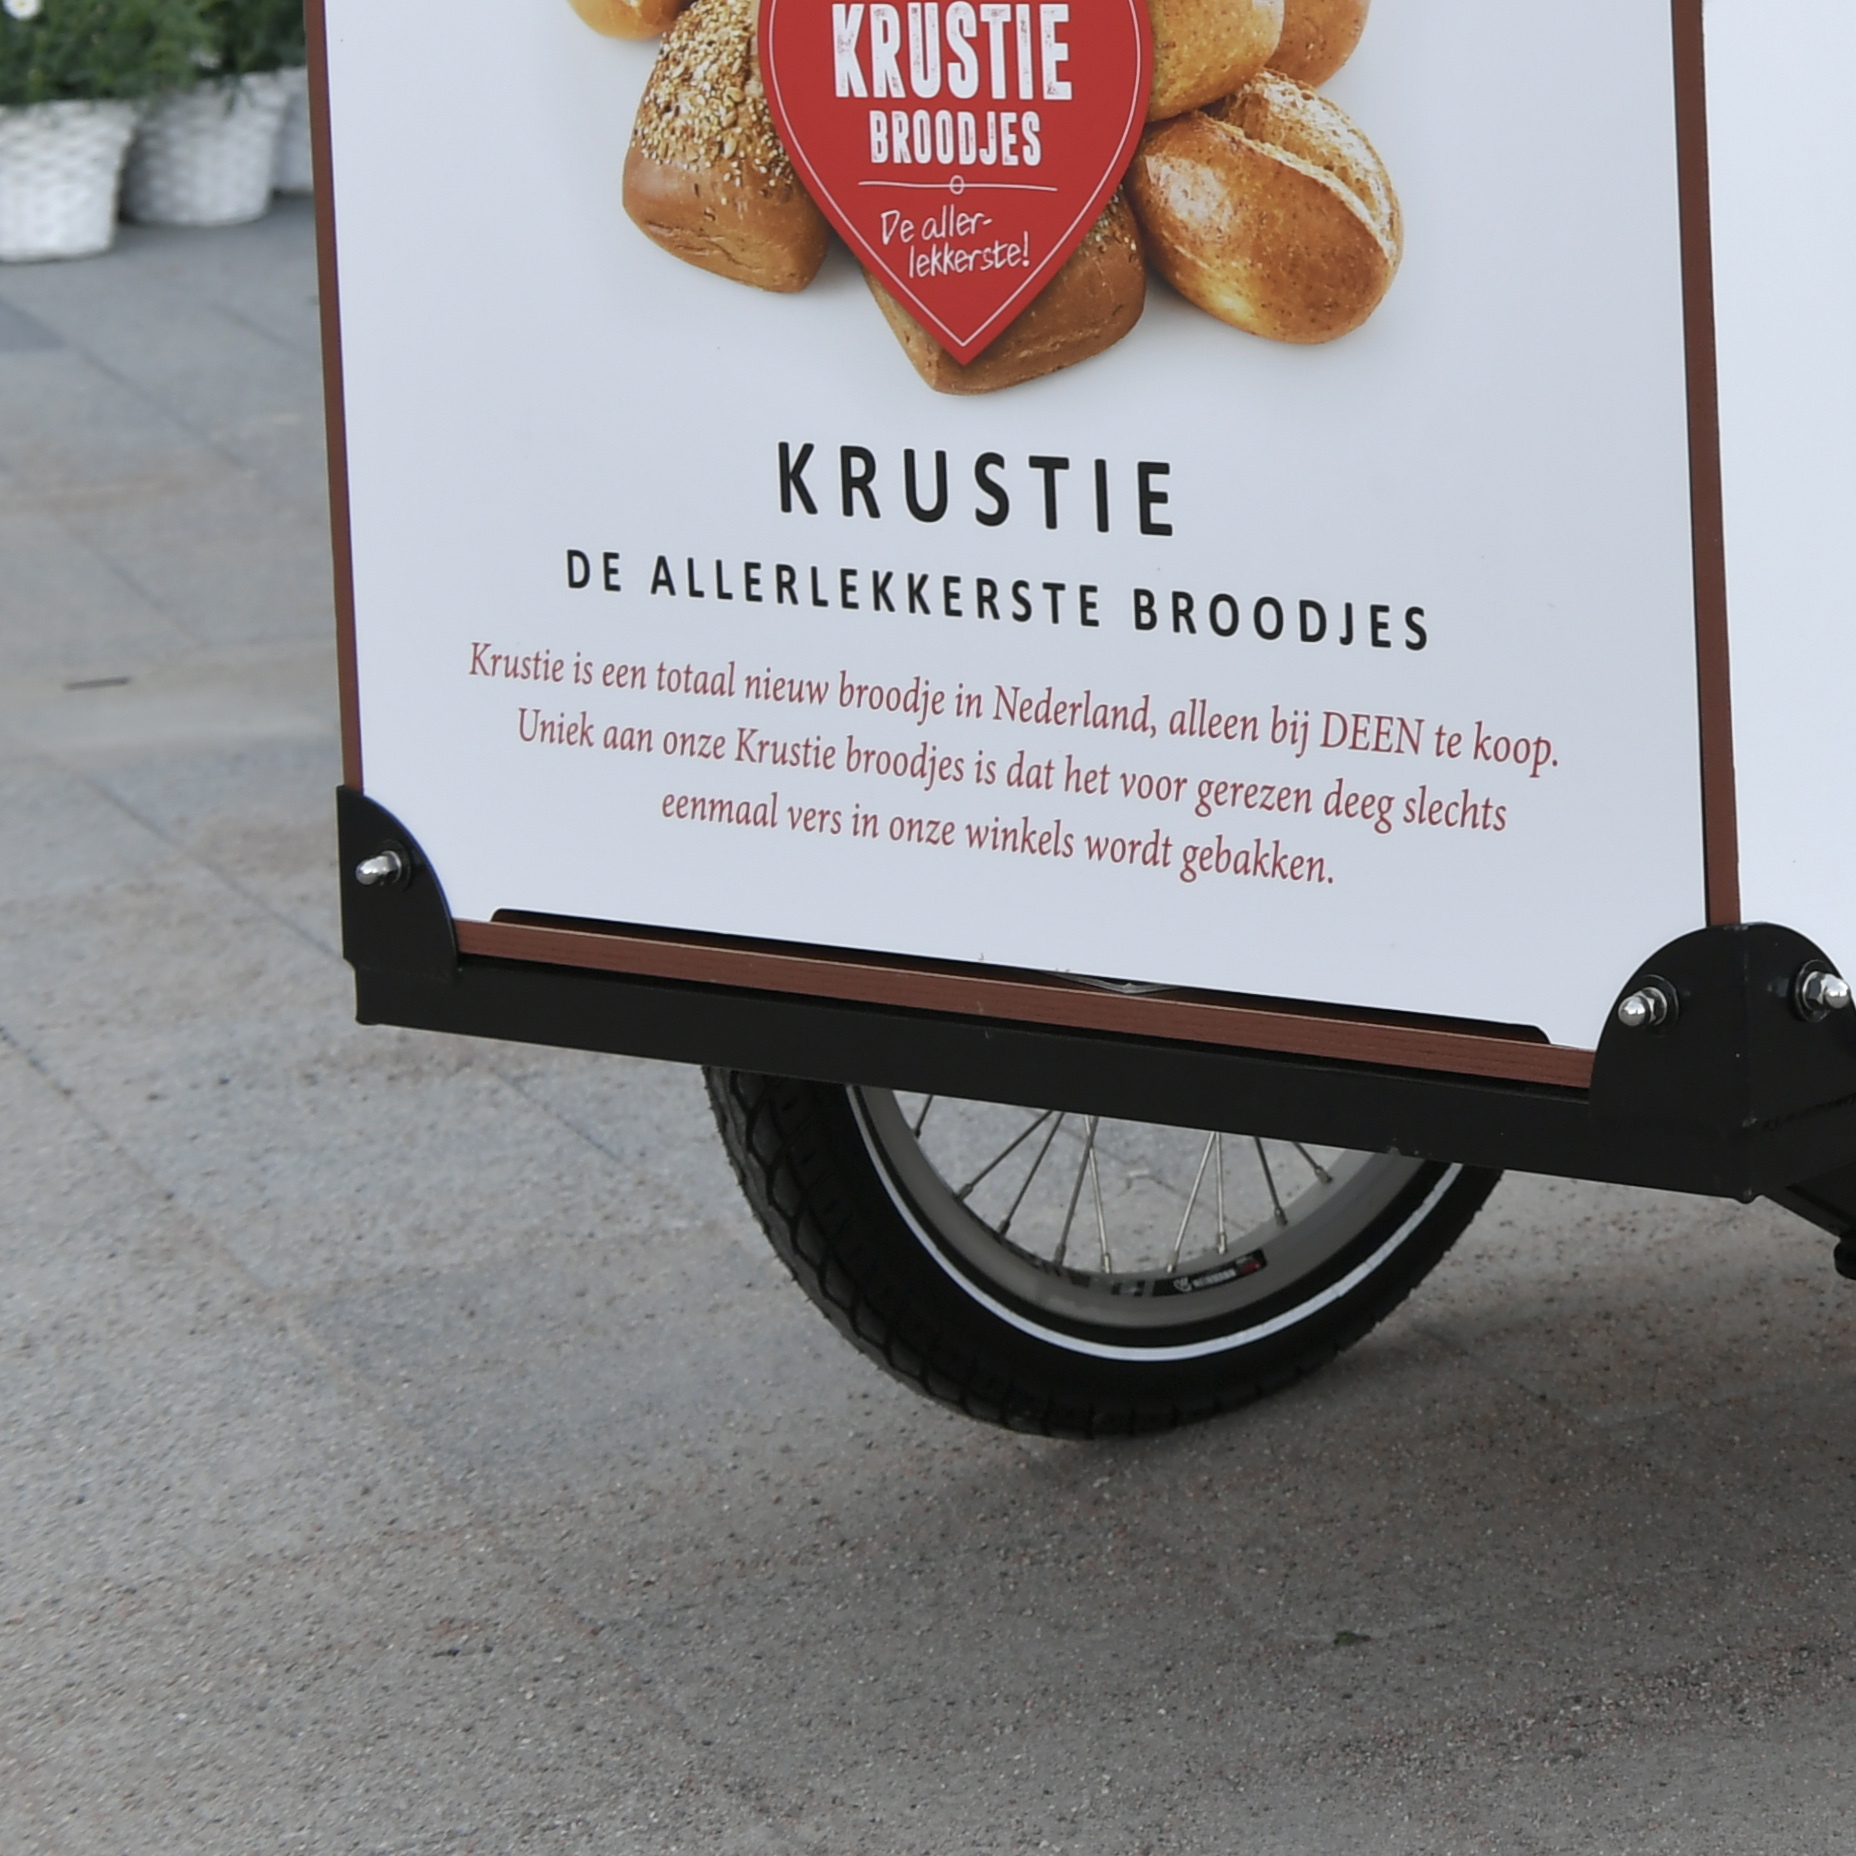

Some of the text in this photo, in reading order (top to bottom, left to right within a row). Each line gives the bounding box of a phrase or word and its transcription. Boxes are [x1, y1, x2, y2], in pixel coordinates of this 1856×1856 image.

[832, 1, 1073, 100] KRUSTIE
[869, 109, 1042, 166] BROODJES
[880, 203, 993, 245] De aller-
[908, 230, 1030, 278] lekkerste!
[778, 442, 1173, 536] KRUSTIE
[567, 549, 1427, 651] DE ALLERLEKKERSTE BROODJES
[470, 643, 1557, 778] Krustie is een totaal nieuw broodje in Nederland, alleen bij DEEN te koop.
[519, 708, 1506, 834] Uniek aan onze Krustie broodjes is dat het voor gerezen deeg slechts
[663, 792, 1333, 883] eenmaal vers in onze winkels wordt gebakken.
